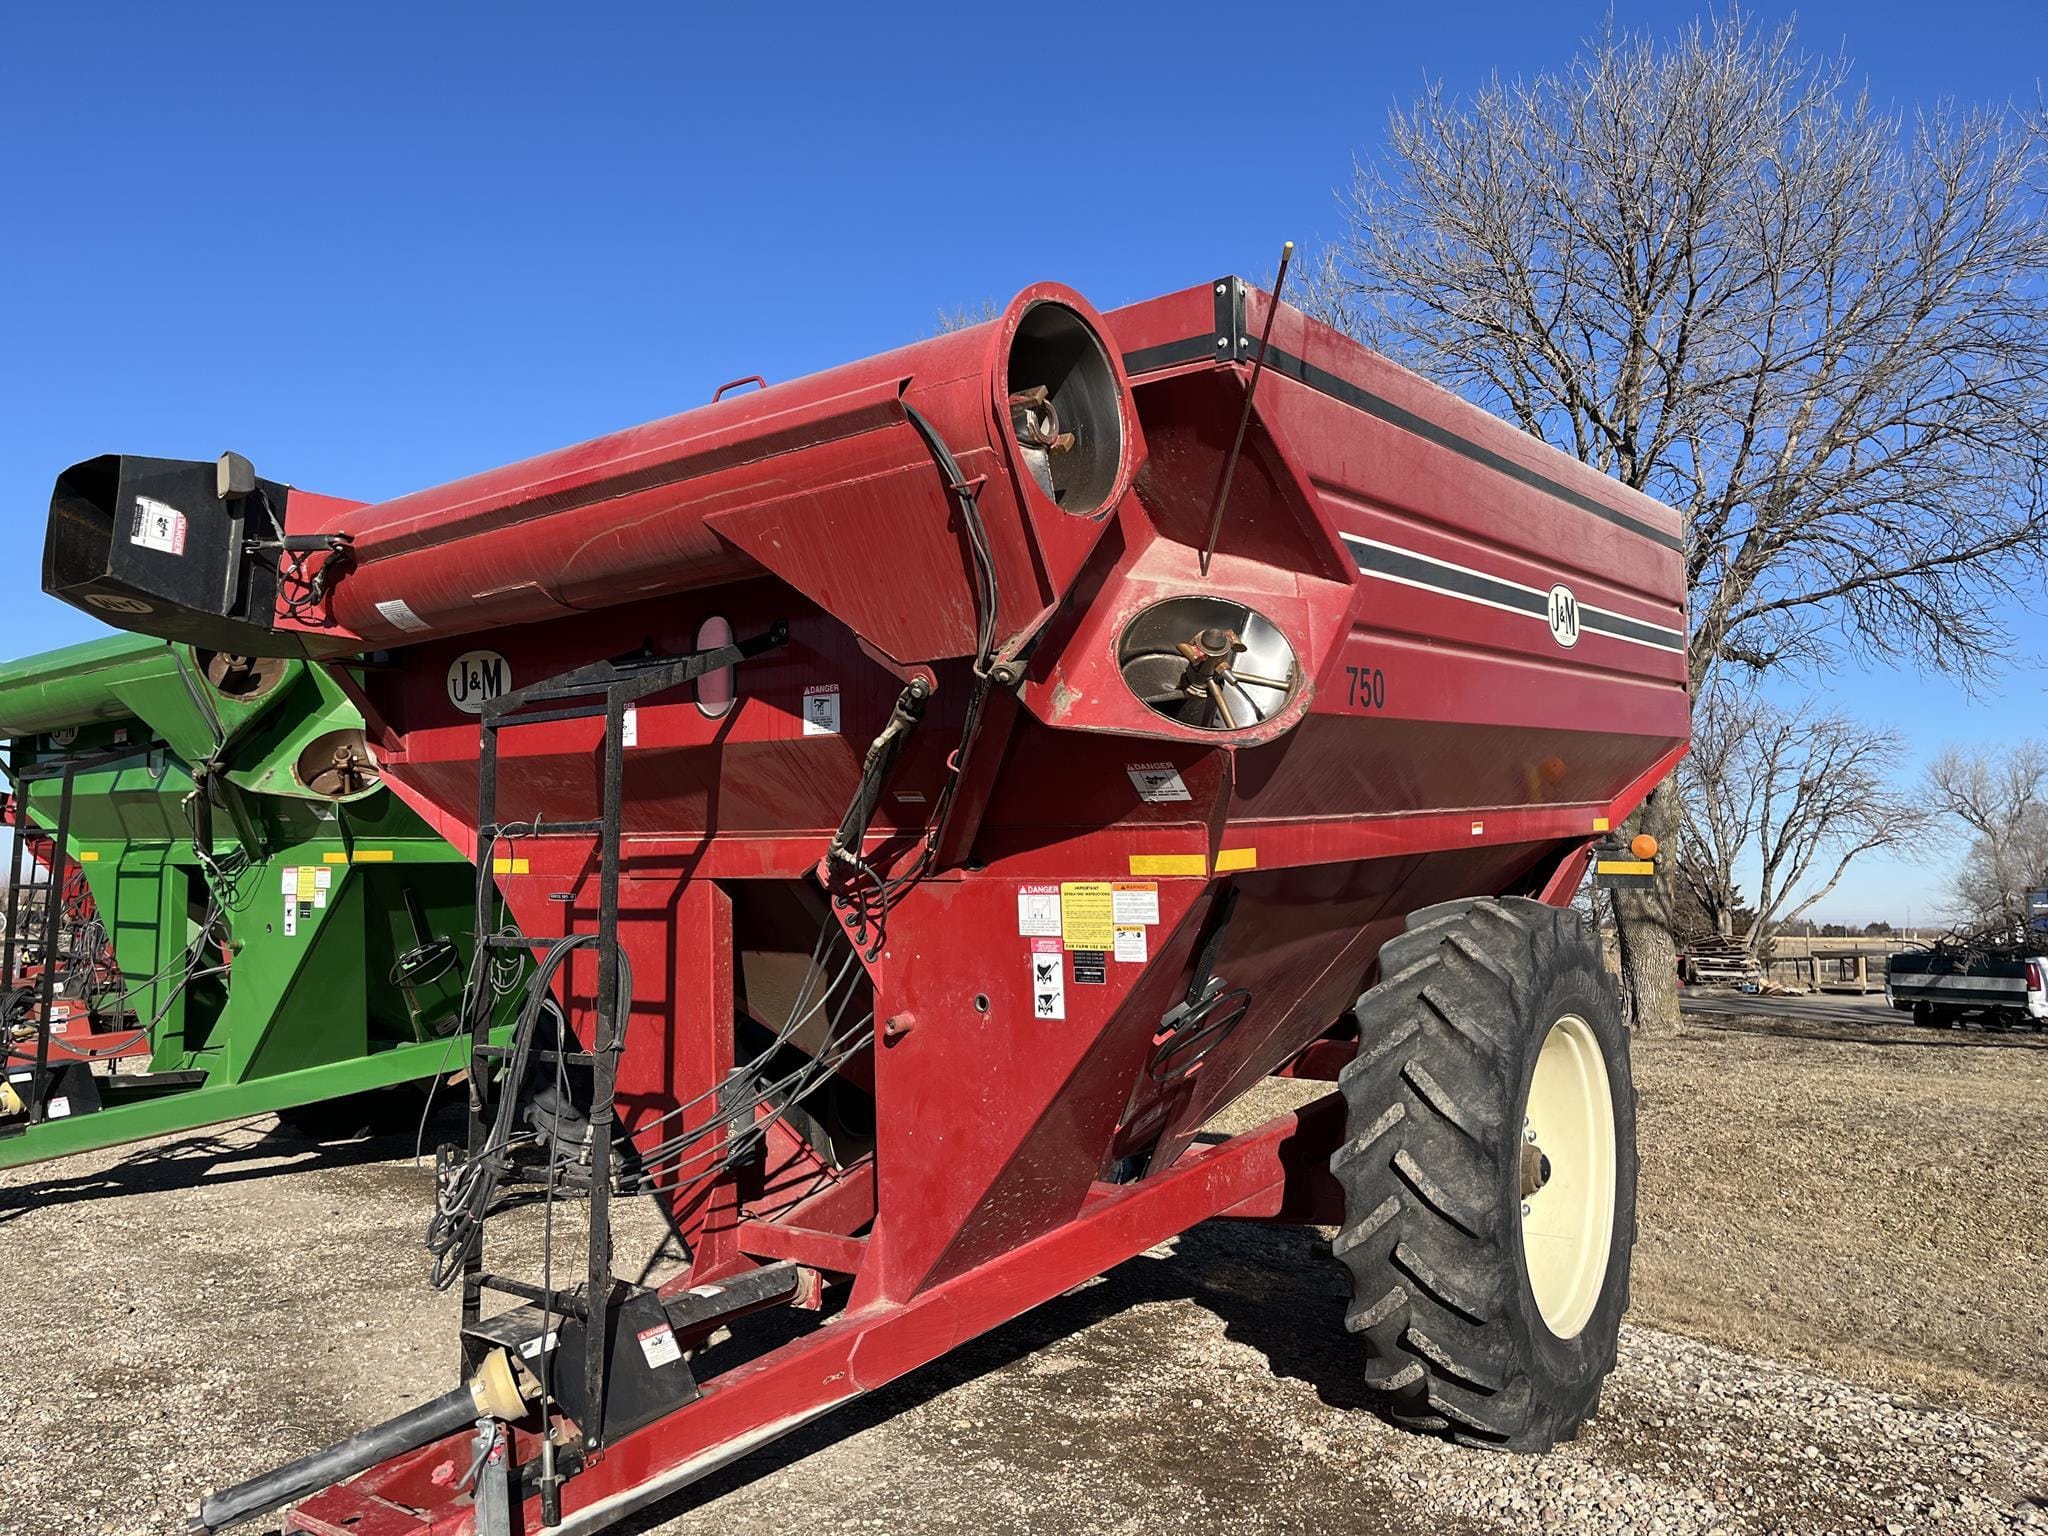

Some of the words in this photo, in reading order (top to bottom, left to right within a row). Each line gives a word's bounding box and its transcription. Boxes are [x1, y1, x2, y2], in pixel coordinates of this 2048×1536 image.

[1551, 593, 1576, 636] J&M
[451, 658, 502, 702] J&M
[810, 683, 839, 694] DANGER
[1346, 666, 1385, 709] 750
[1133, 762, 1175, 771] DANGER
[1028, 885, 1059, 894] DANGER
